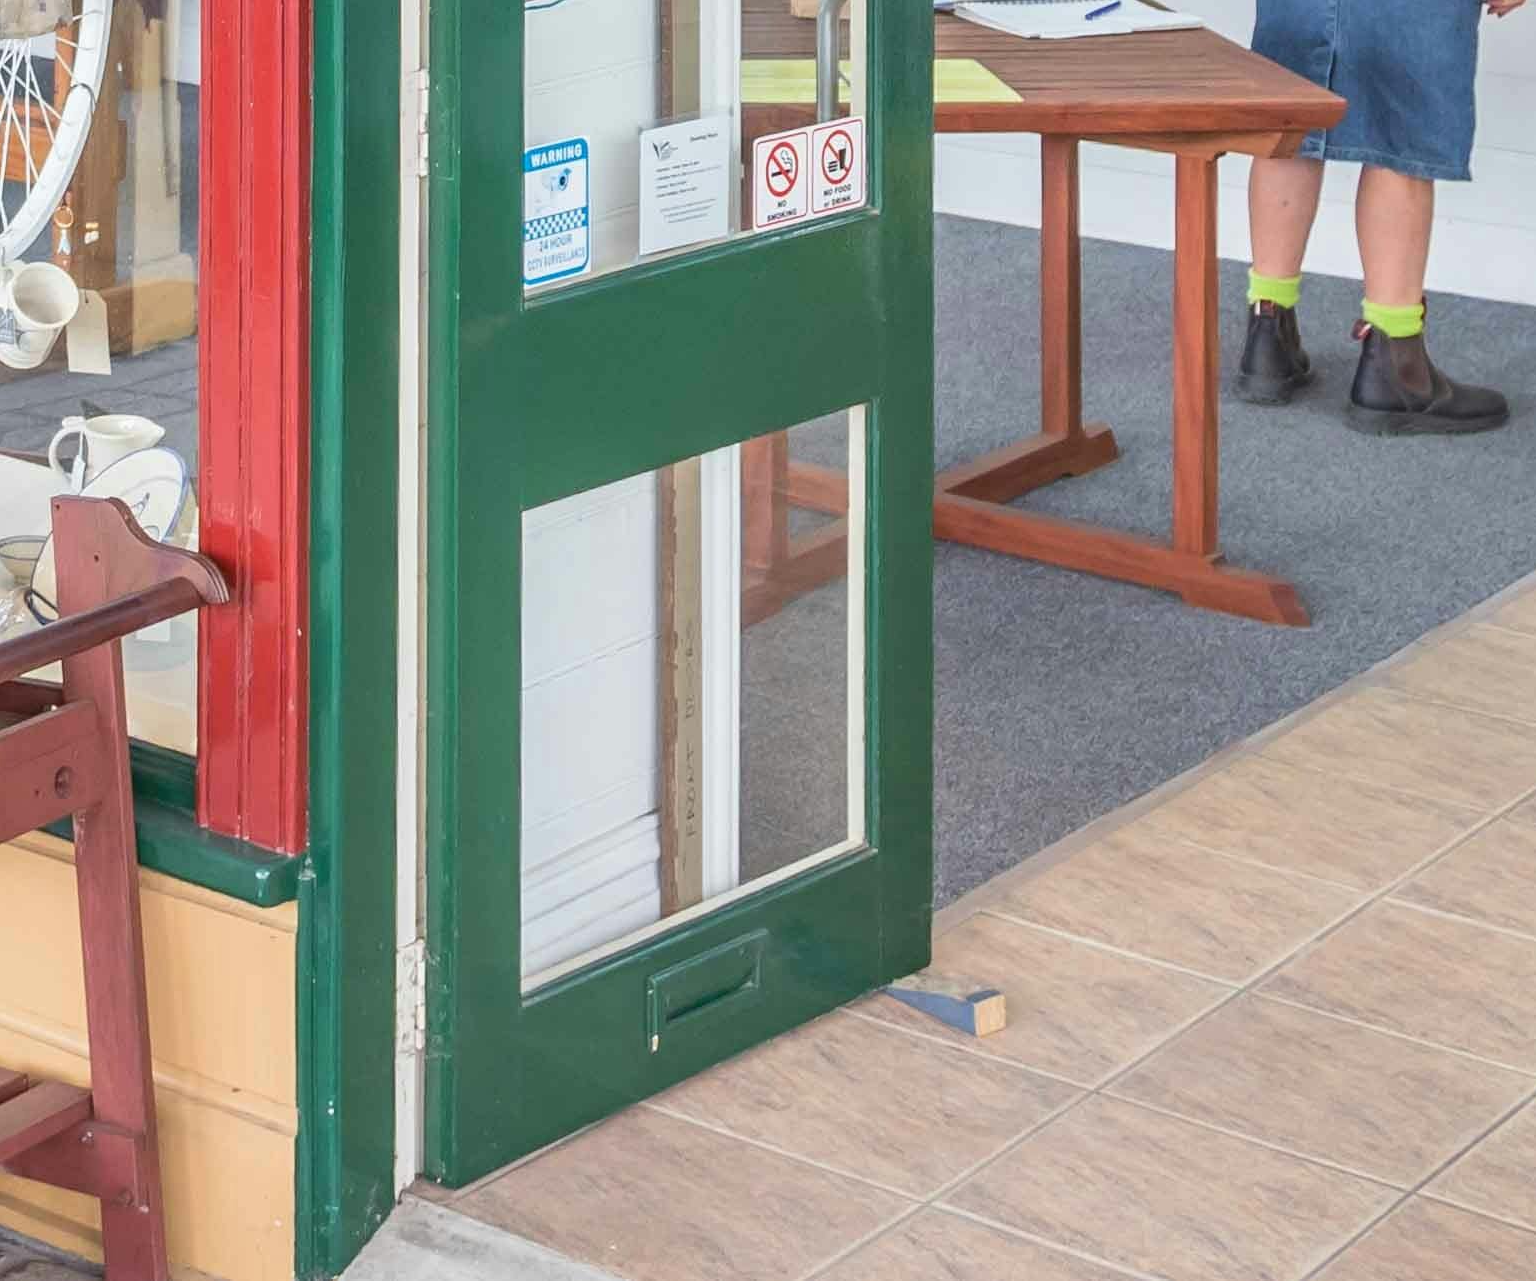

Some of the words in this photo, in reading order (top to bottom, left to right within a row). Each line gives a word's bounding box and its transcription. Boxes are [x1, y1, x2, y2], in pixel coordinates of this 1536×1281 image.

[531, 144, 583, 169] WARNING
[823, 187, 833, 196] NO
[834, 184, 852, 194] FOOD
[777, 199, 788, 208] NO
[832, 196, 852, 206] DRINK
[767, 208, 798, 222] SMOKING
[550, 234, 573, 251] HOUR
